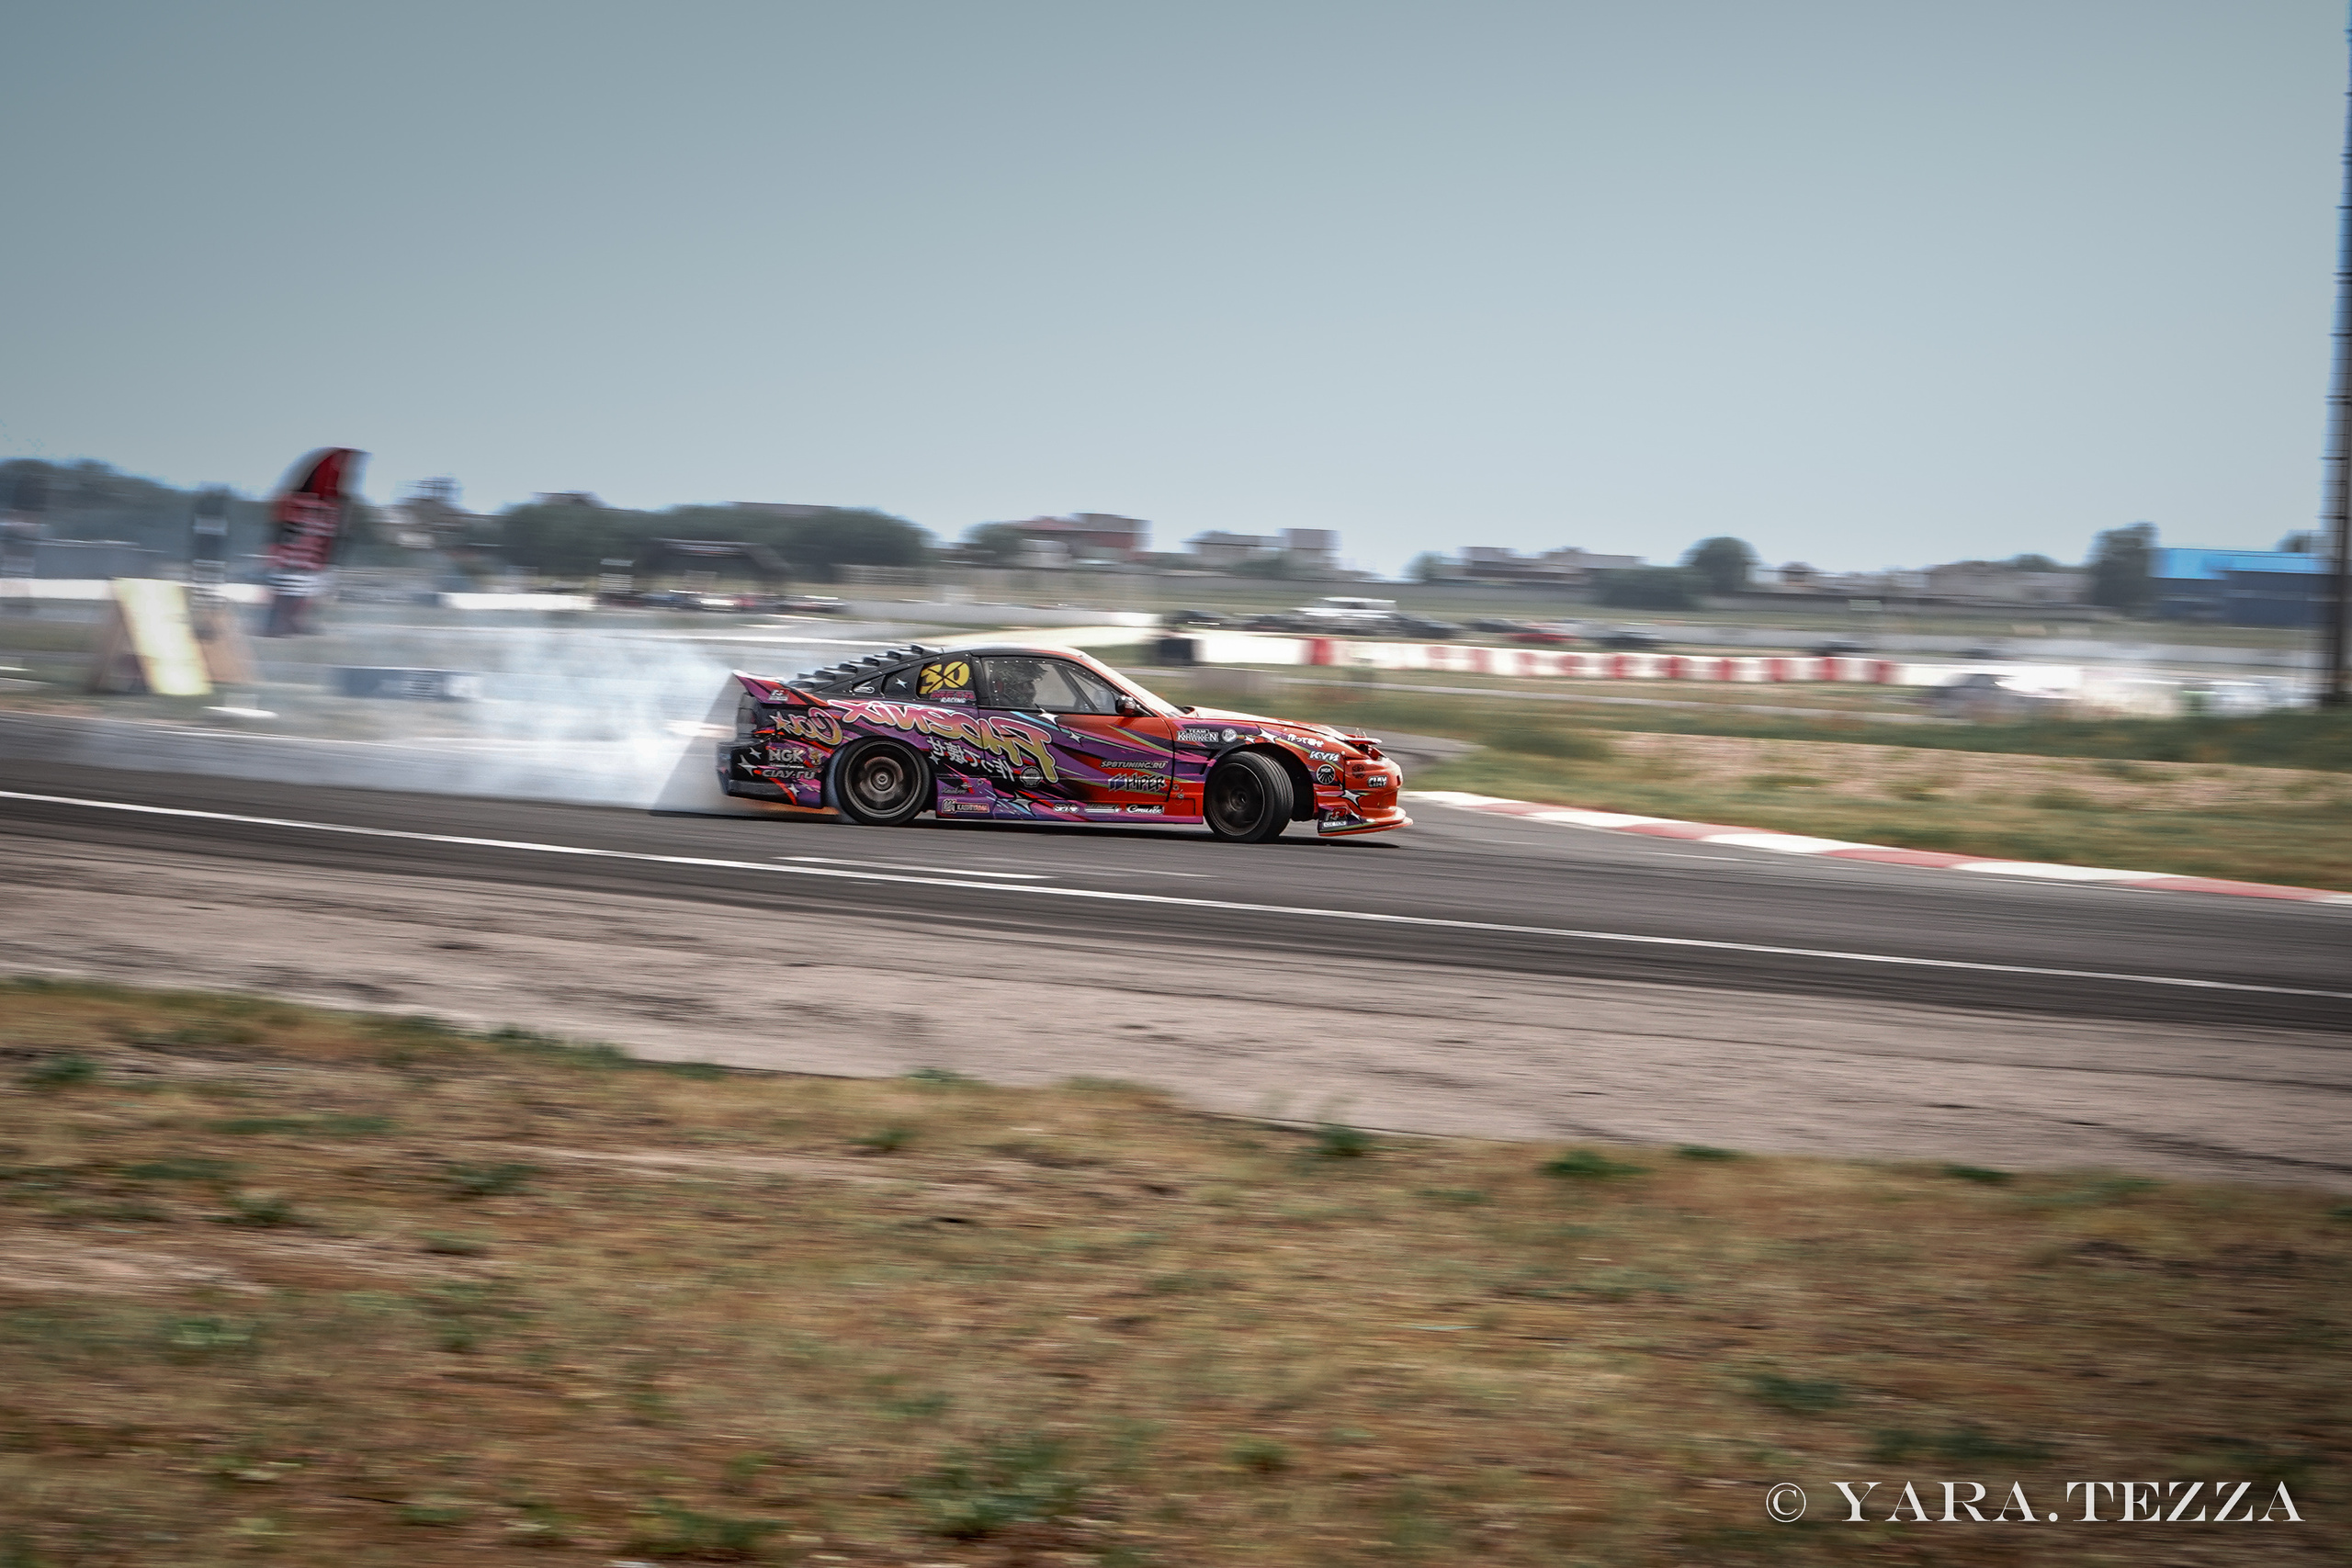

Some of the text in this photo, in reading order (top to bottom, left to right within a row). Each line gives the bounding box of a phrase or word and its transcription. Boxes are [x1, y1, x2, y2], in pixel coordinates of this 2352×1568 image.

[919, 661, 970, 694] 30
[1178, 731, 1218, 742] KRAKEN
[768, 748, 805, 762] NGK
[1310, 750, 1340, 762] KYB
[1102, 761, 1167, 769] SPBTUNING.RU
[1126, 773, 1167, 791] HIPER
